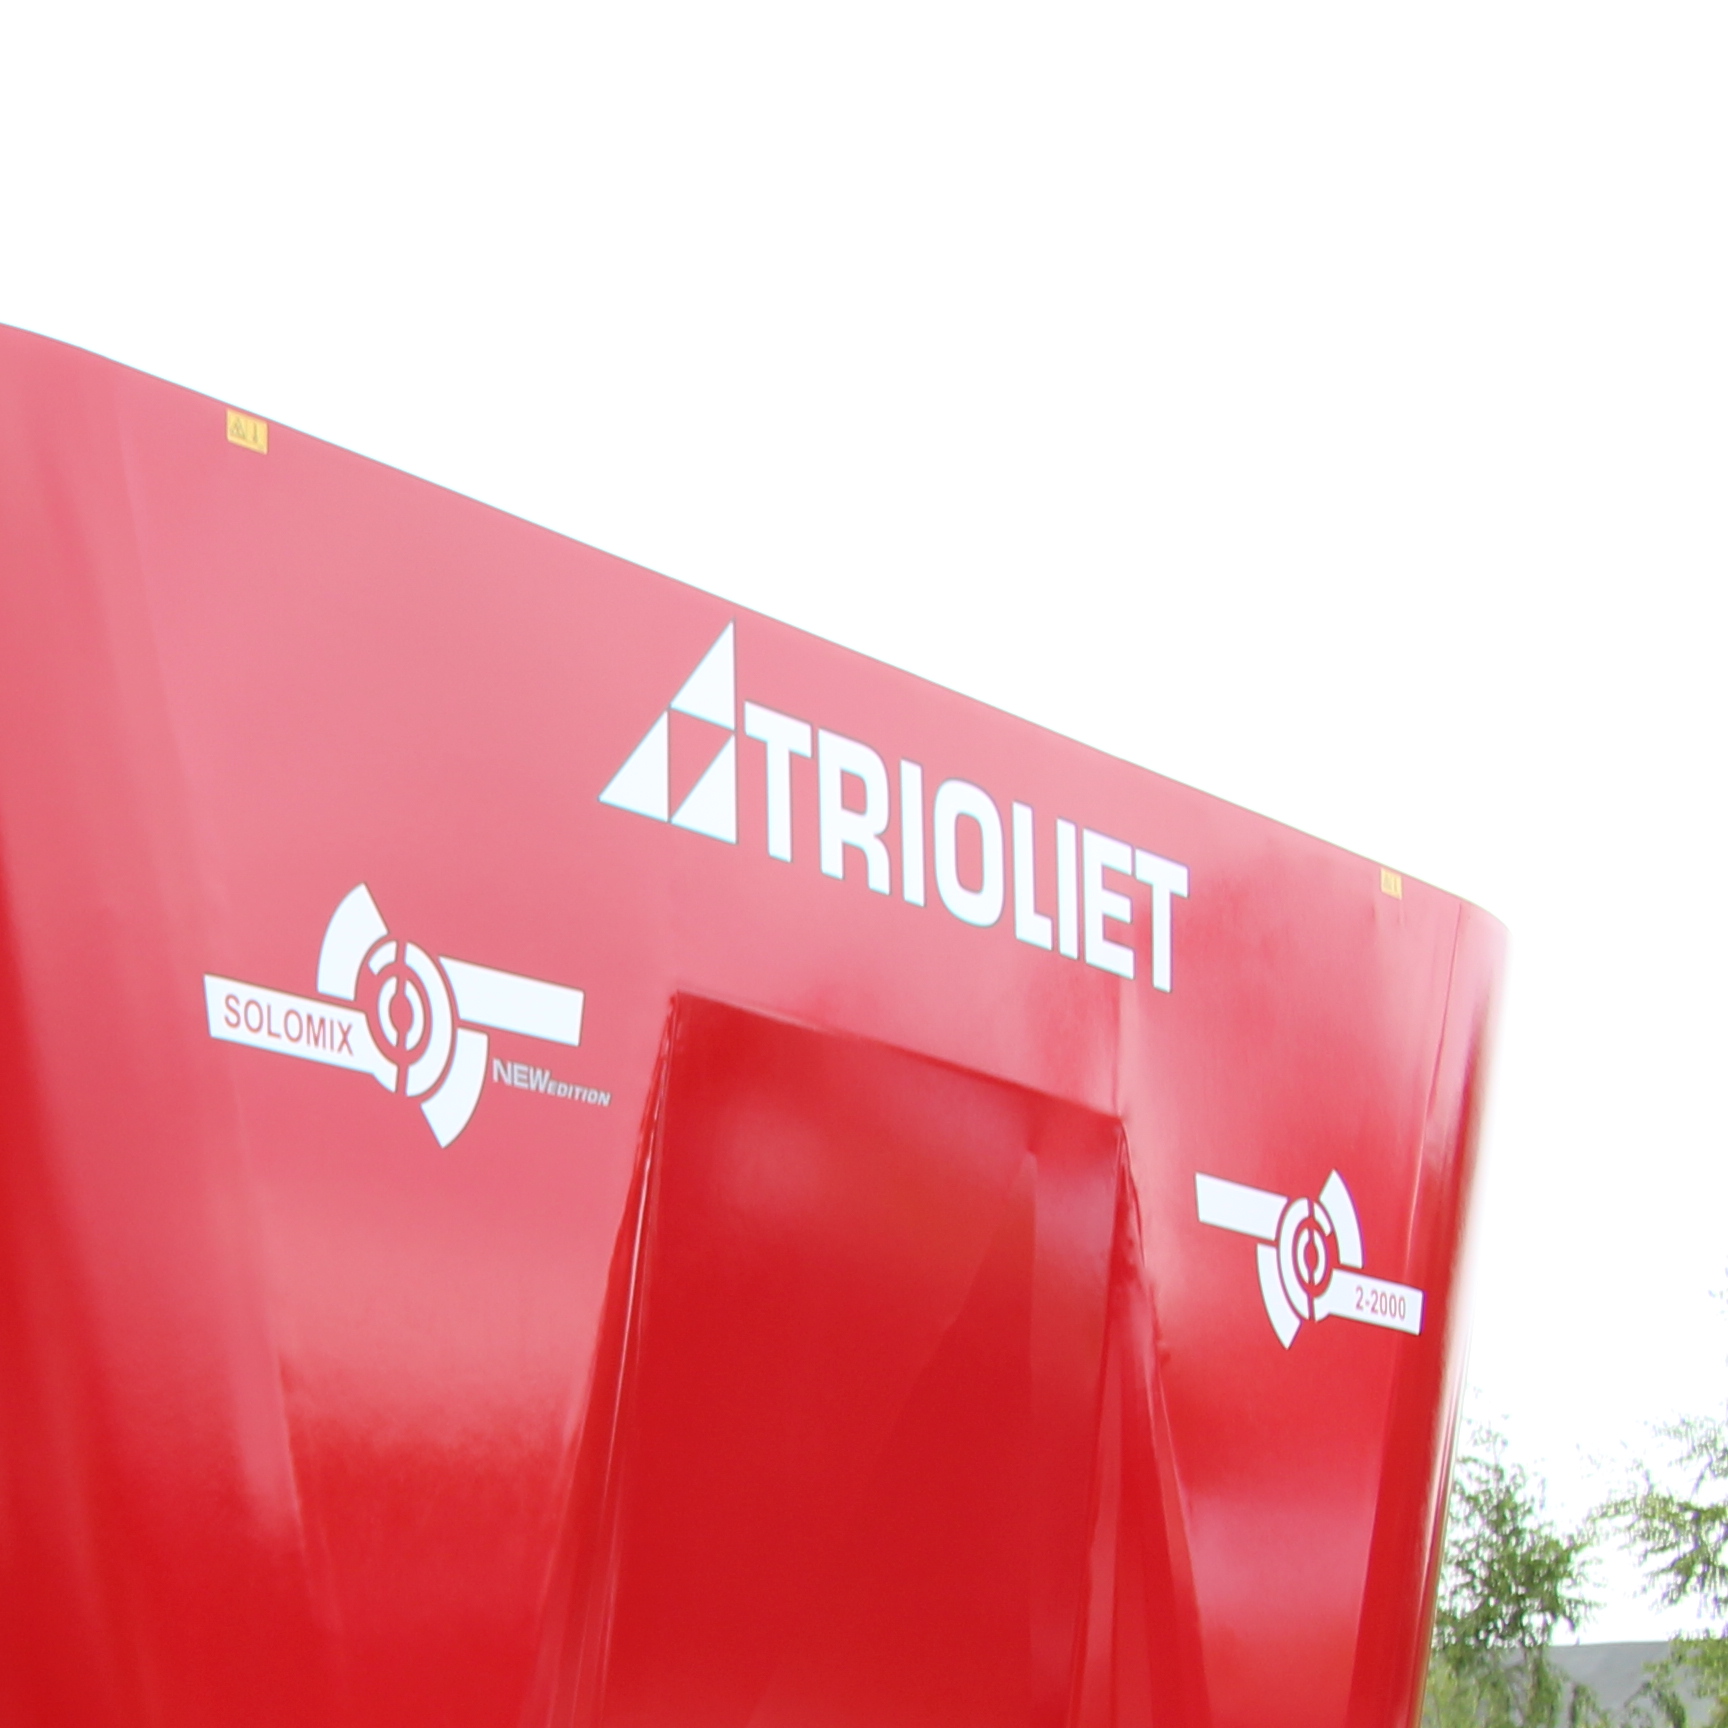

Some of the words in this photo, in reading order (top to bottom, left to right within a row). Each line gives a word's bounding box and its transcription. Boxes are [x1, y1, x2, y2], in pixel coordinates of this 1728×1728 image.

[743, 699, 1190, 994] TRIOLIET
[223, 993, 354, 1057] SOLOMIX
[1355, 1285, 1406, 1321] 2-2000
